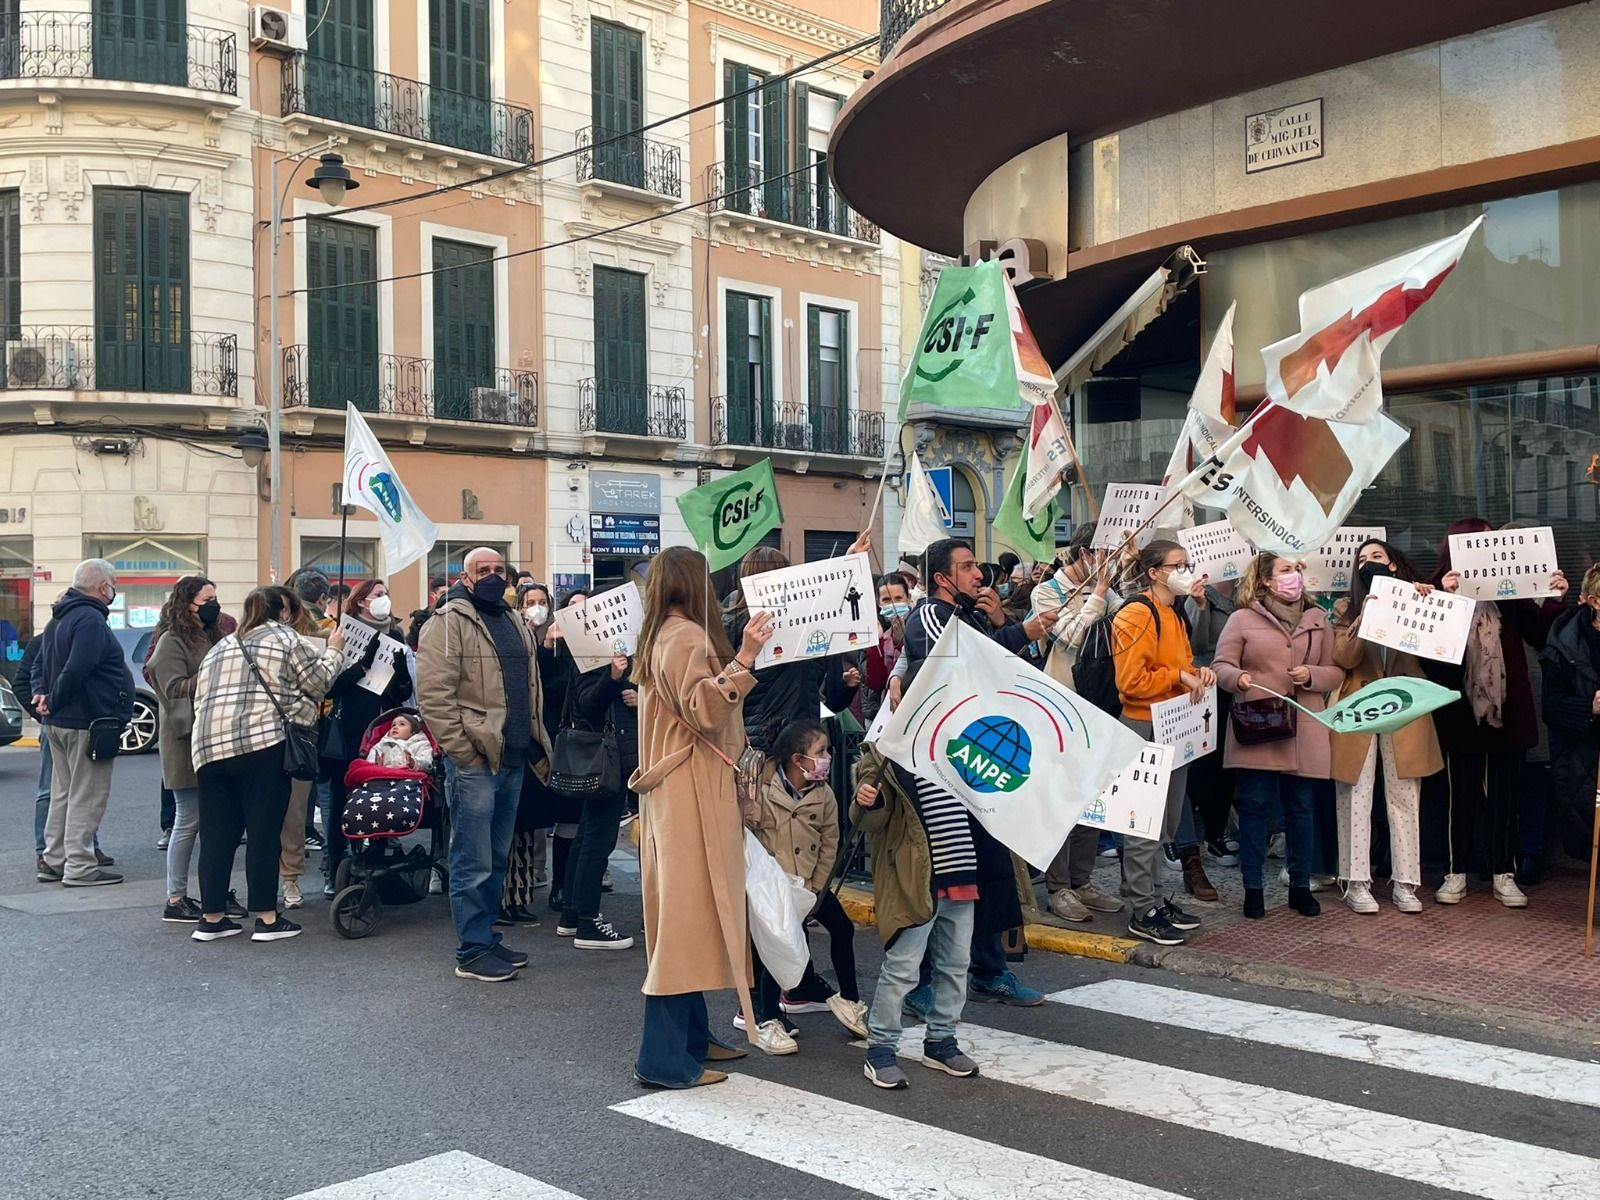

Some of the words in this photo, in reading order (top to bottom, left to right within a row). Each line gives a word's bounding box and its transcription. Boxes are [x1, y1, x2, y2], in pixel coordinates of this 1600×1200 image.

[1279, 112, 1312, 127] CALLE
[1271, 125, 1317, 144] MIGUEL
[1248, 153, 1260, 164] DE
[1261, 140, 1319, 160] CERVANTES
[1114, 489, 1149, 501] RESPETO
[1123, 504, 1140, 514] LOS
[1231, 485, 1305, 551] INTERSINDICAL
[1319, 546, 1332, 555] RD
[1466, 535, 1524, 549] RESPETO
[1534, 534, 1539, 543] A
[1325, 559, 1351, 568] TODO
[1493, 551, 1517, 562] LOS
[1464, 563, 1548, 579] OPOSITORES
[758, 569, 853, 597] ¿ESPECIALIDADES?
[575, 609, 588, 620] EL
[593, 592, 627, 613] MISMO
[761, 588, 822, 608] ¿VACANTES?
[1391, 585, 1403, 597] EL
[1411, 592, 1453, 610] MISMO
[584, 619, 598, 632] RD
[604, 607, 628, 623] PARA
[1392, 600, 1406, 612] RD
[1414, 607, 1445, 622] PARA
[595, 622, 628, 641] TODOS
[1396, 615, 1435, 633] TODOS
[805, 642, 830, 654] ANPE
[951, 744, 1012, 790] ANPE
[1140, 751, 1156, 765] LA
[1133, 769, 1158, 785] DEL
